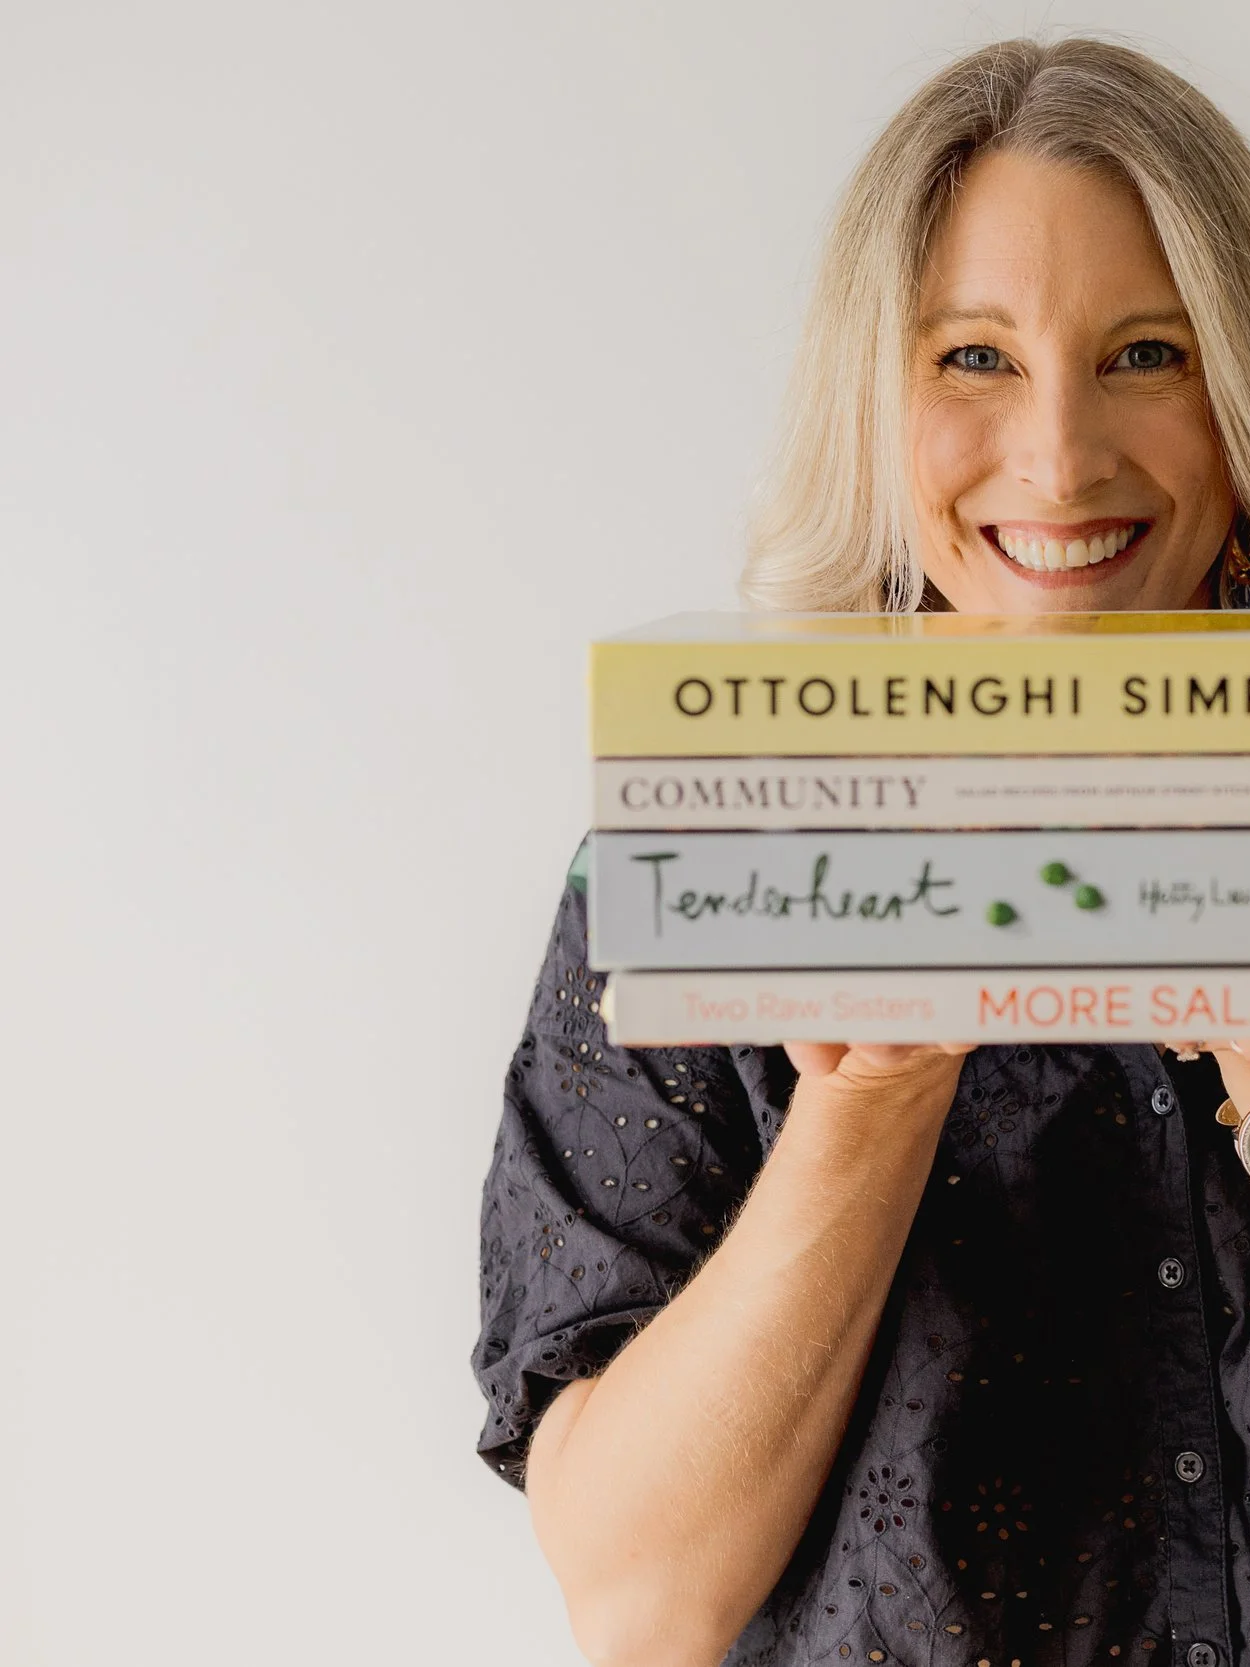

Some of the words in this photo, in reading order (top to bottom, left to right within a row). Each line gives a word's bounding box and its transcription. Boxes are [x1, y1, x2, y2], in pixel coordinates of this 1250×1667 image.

[673, 675, 1081, 718] OTTOLENGHI
[619, 776, 927, 811] COMMUNITY
[629, 850, 962, 938] Tenderheart
[683, 991, 749, 1021] Two
[756, 991, 824, 1021] Raw
[831, 990, 936, 1021] Sisters
[978, 986, 1131, 1027] MORE
